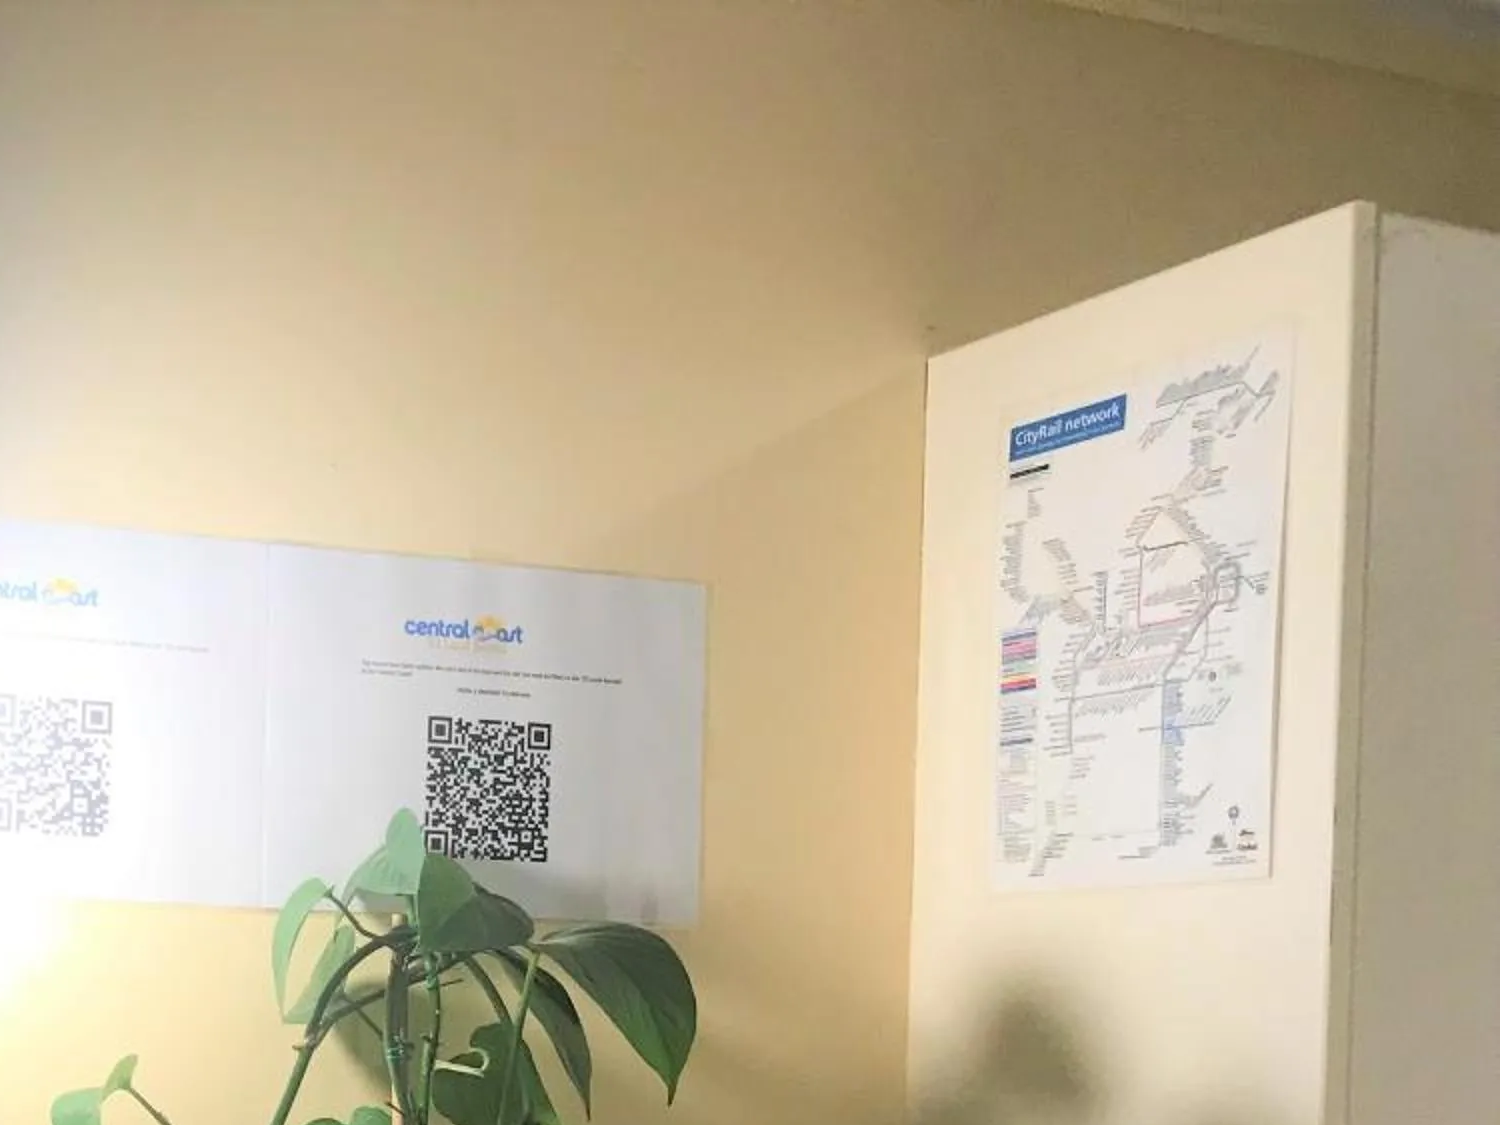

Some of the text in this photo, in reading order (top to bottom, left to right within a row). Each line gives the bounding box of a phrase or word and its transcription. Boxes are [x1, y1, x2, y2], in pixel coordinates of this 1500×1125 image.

[1014, 402, 1120, 446] CityRail network
[404, 618, 471, 639] central
